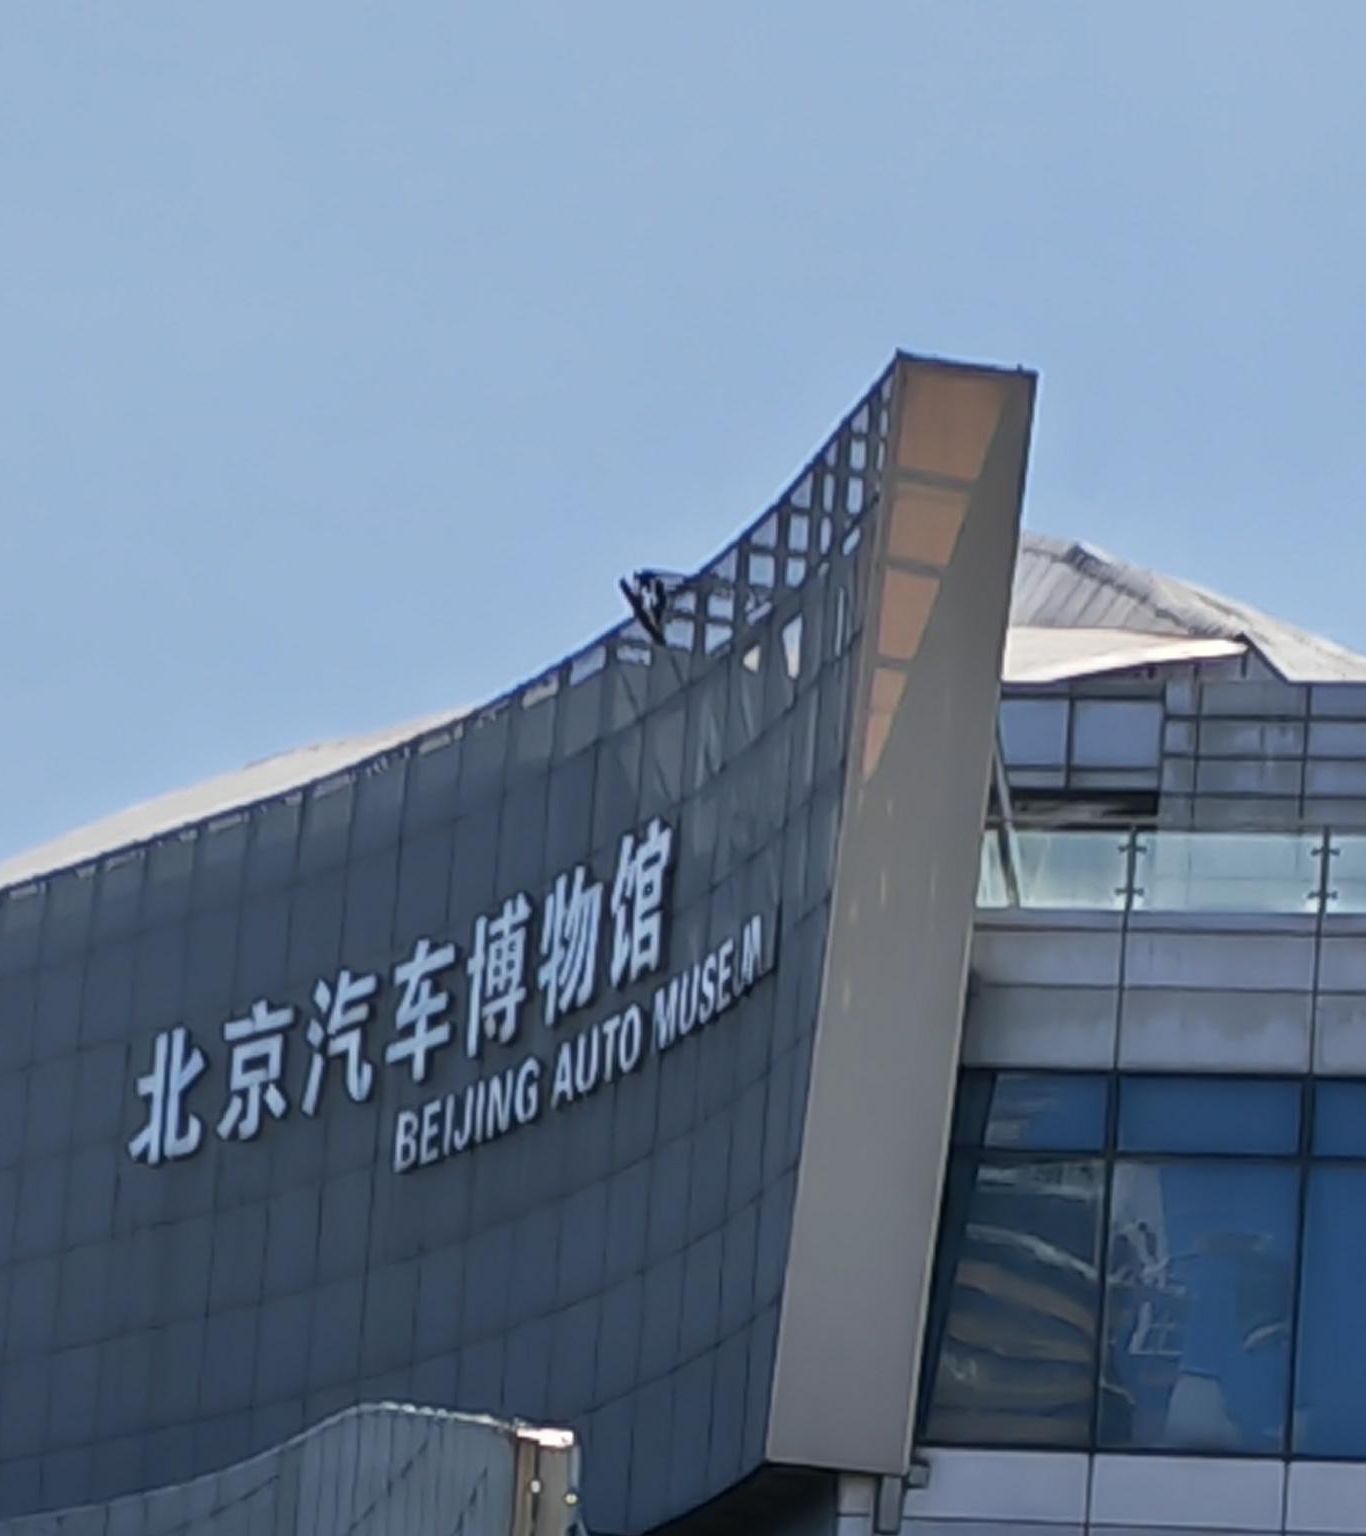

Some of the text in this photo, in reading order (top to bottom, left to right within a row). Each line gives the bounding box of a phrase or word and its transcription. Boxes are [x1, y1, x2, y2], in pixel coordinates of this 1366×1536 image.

[129, 817, 673, 1166] 北京汽车博物馆
[392, 1056, 542, 1174] BEIJING
[550, 1002, 643, 1109] AUTO
